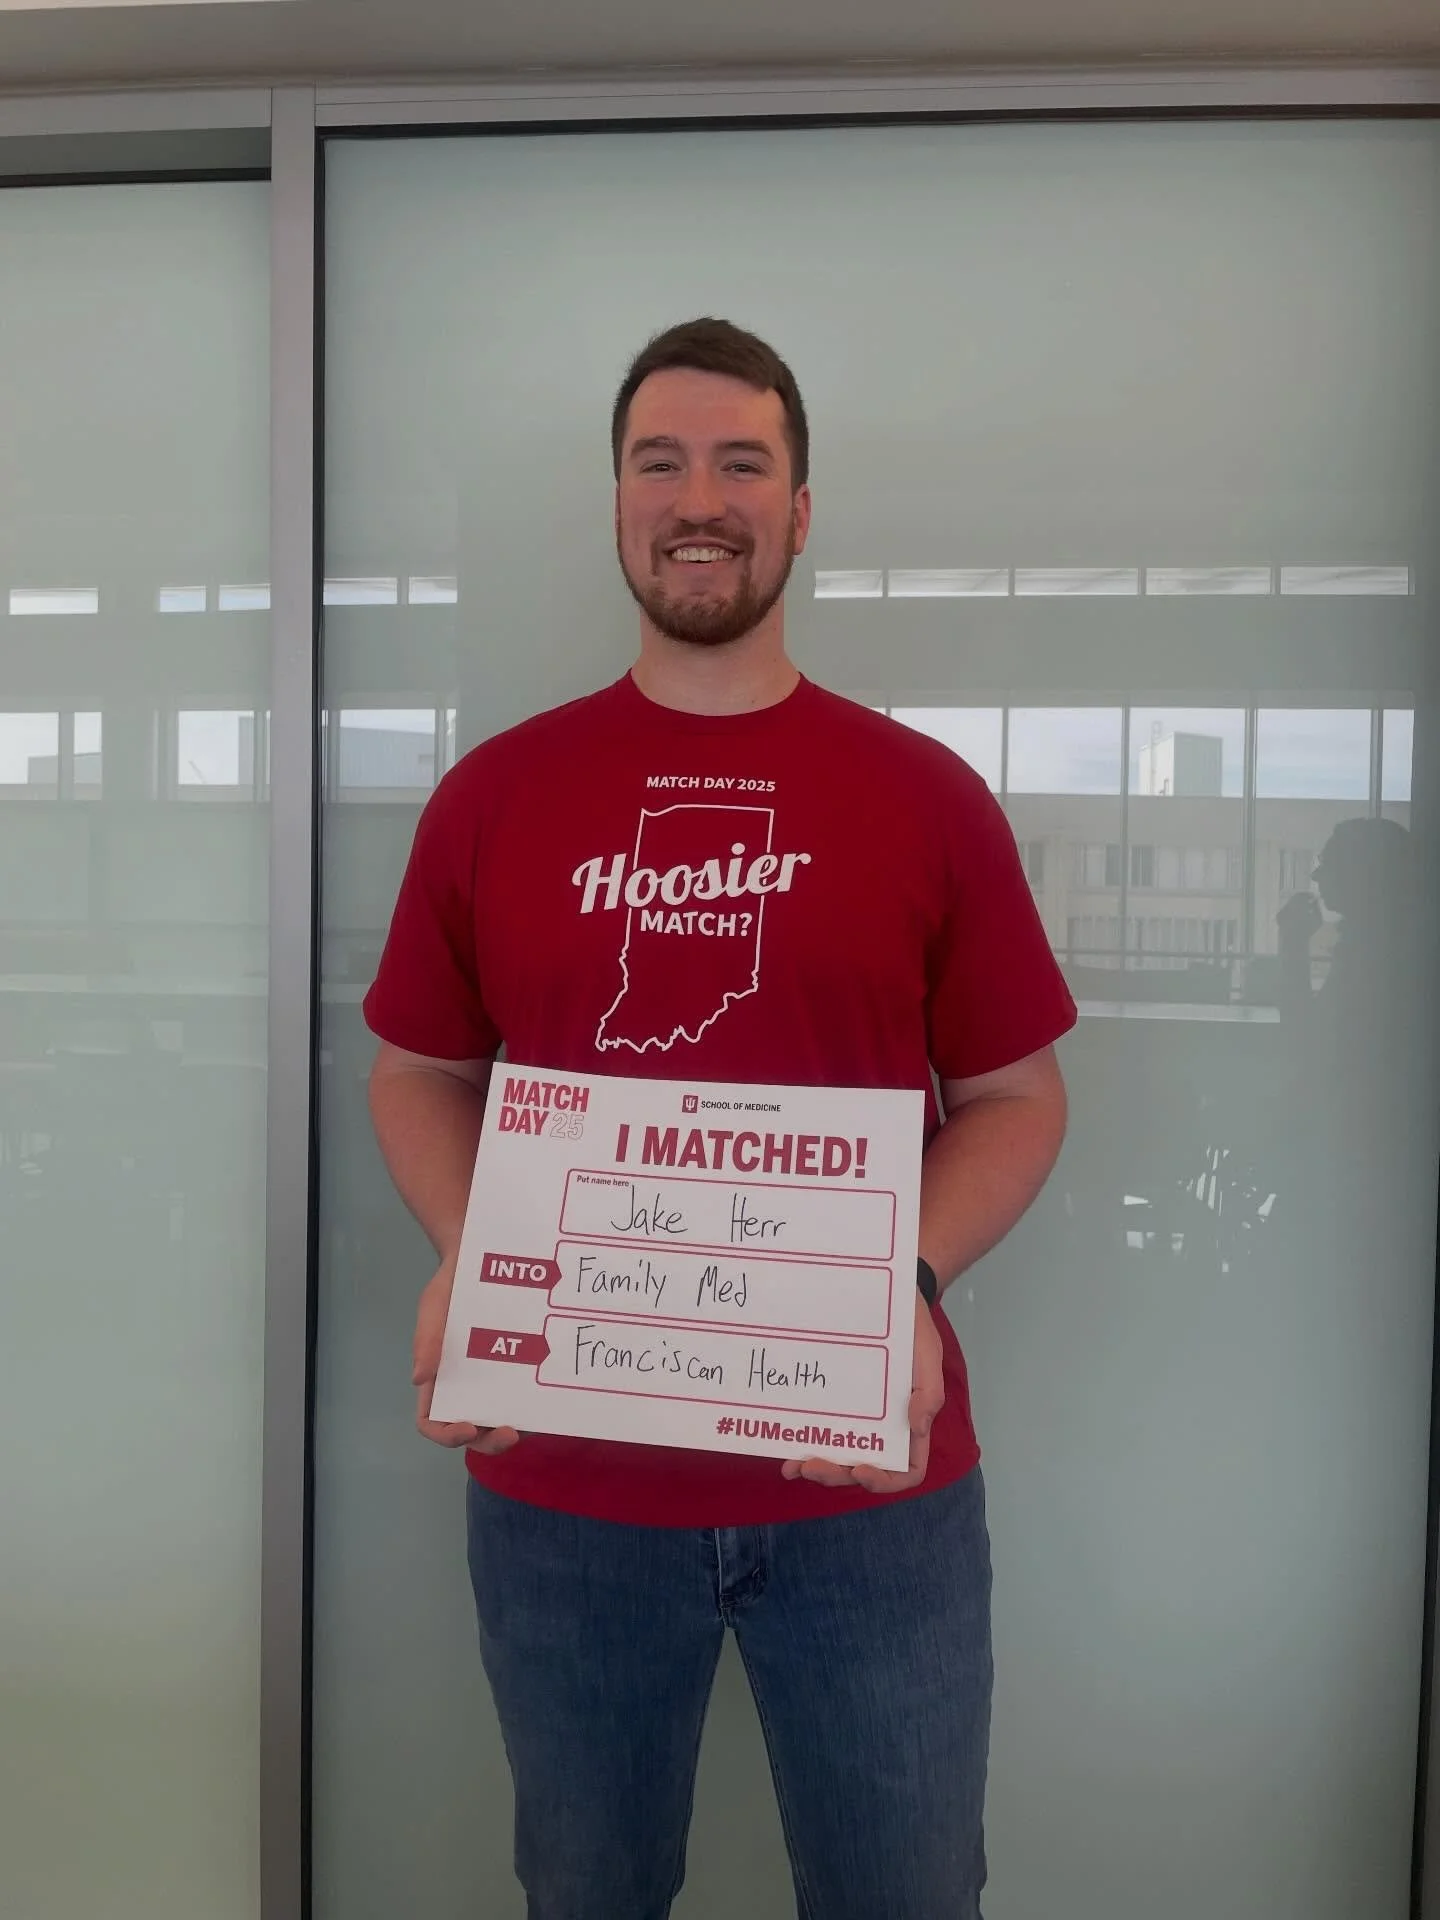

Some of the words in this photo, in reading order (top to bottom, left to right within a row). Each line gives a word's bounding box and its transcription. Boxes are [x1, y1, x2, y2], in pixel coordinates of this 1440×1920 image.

[646, 776, 700, 789] MATCH
[703, 777, 735, 789] DAY
[737, 778, 776, 792] 2025
[571, 842, 812, 914] Hoosier
[640, 909, 753, 937] MATCH?
[503, 1077, 590, 1113] MATCH
[701, 1100, 732, 1110] SCHOOL
[733, 1102, 743, 1111] OF
[745, 1102, 781, 1113] MEDICINE
[498, 1106, 549, 1136] DAY
[549, 1112, 585, 1140] 25
[615, 1124, 630, 1163] I
[641, 1127, 868, 1179] MATCHED!
[576, 1174, 590, 1185] Put
[590, 1177, 612, 1186] name
[612, 1178, 629, 1187] here
[611, 1185, 689, 1235] Jake
[730, 1192, 787, 1243] Herr
[489, 1260, 547, 1283] INTO
[576, 1256, 668, 1308] Family
[697, 1265, 748, 1308] Med
[490, 1336, 522, 1356] AT
[575, 1325, 723, 1385] Franciscan
[748, 1348, 827, 1392] Health
[716, 1416, 885, 1452] #IUMedMatch
